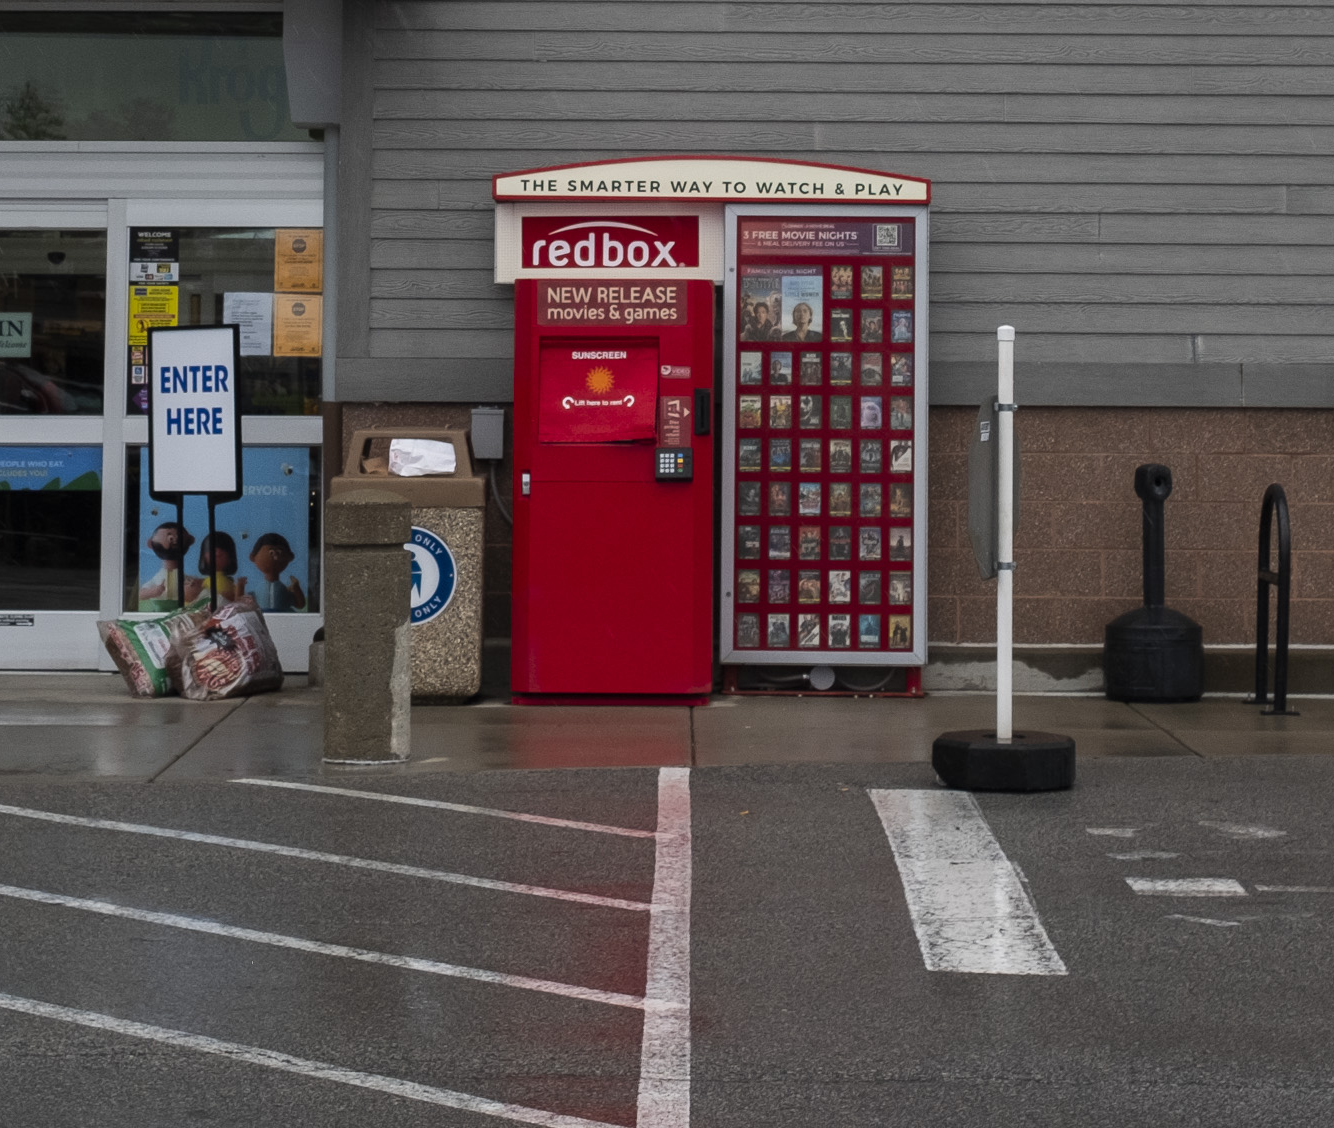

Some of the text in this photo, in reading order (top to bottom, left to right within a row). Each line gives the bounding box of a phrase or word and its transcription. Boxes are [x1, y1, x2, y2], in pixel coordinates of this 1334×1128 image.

[521, 179, 903, 196] THE SMARTER WAY TO WATCH & PLAY
[743, 231, 858, 241] 3 FREE MOVIE NIGHTS
[533, 233, 677, 267] redbox
[547, 287, 677, 304] NEW RELEASE
[547, 304, 677, 324] movies & games
[572, 351, 627, 360] SUNSCREEN
[161, 365, 229, 393] ENTER
[167, 407, 223, 435] HERE
[27, 460, 47, 468] WHO
[243, 485, 288, 496] ERYONE
[415, 534, 443, 555] ONLY
[415, 596, 441, 618] ONLY
